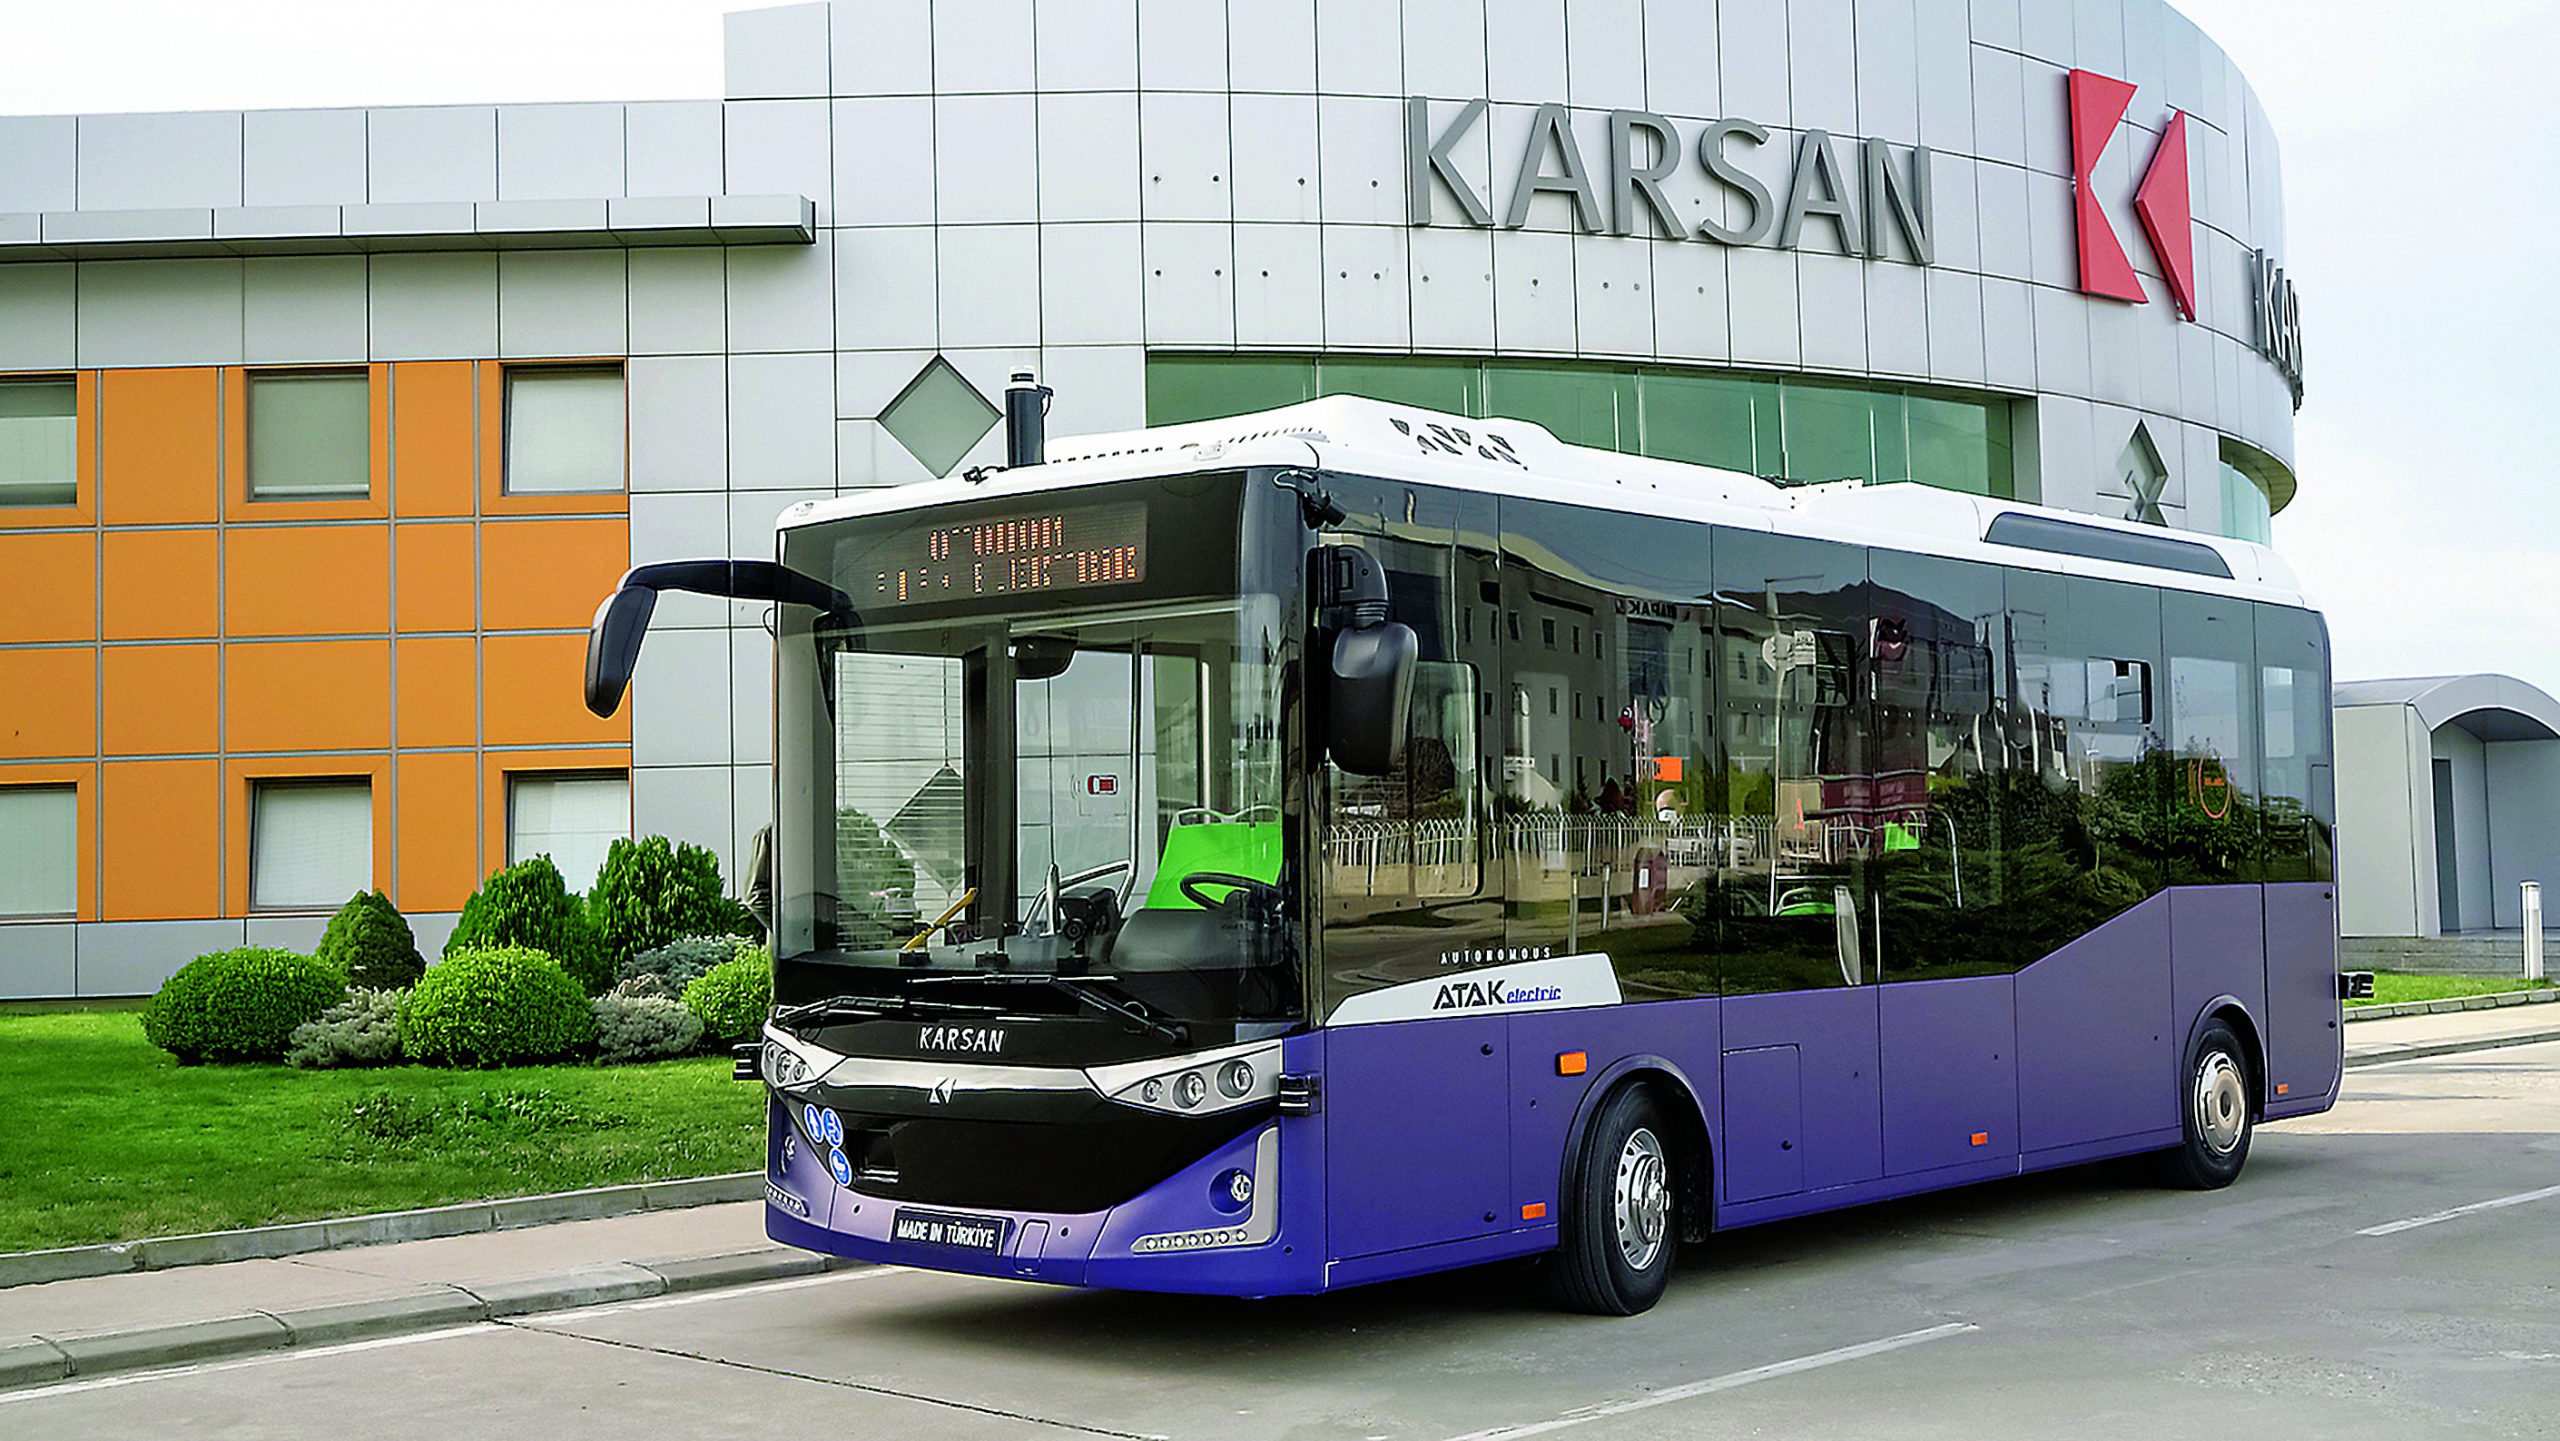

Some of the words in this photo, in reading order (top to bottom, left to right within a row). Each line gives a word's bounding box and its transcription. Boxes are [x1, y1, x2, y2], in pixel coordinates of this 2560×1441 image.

[1407, 95, 1933, 266] KARSAN
[1440, 946, 1551, 965] AUTONOMOUS
[1433, 979, 1506, 1010] ATAK
[1506, 985, 1562, 1004] electric
[920, 1026, 1005, 1053] KARSAN
[897, 1219, 929, 1241] MADE
[929, 1222, 944, 1243] IN
[946, 1220, 996, 1248] TÜRKİYE
